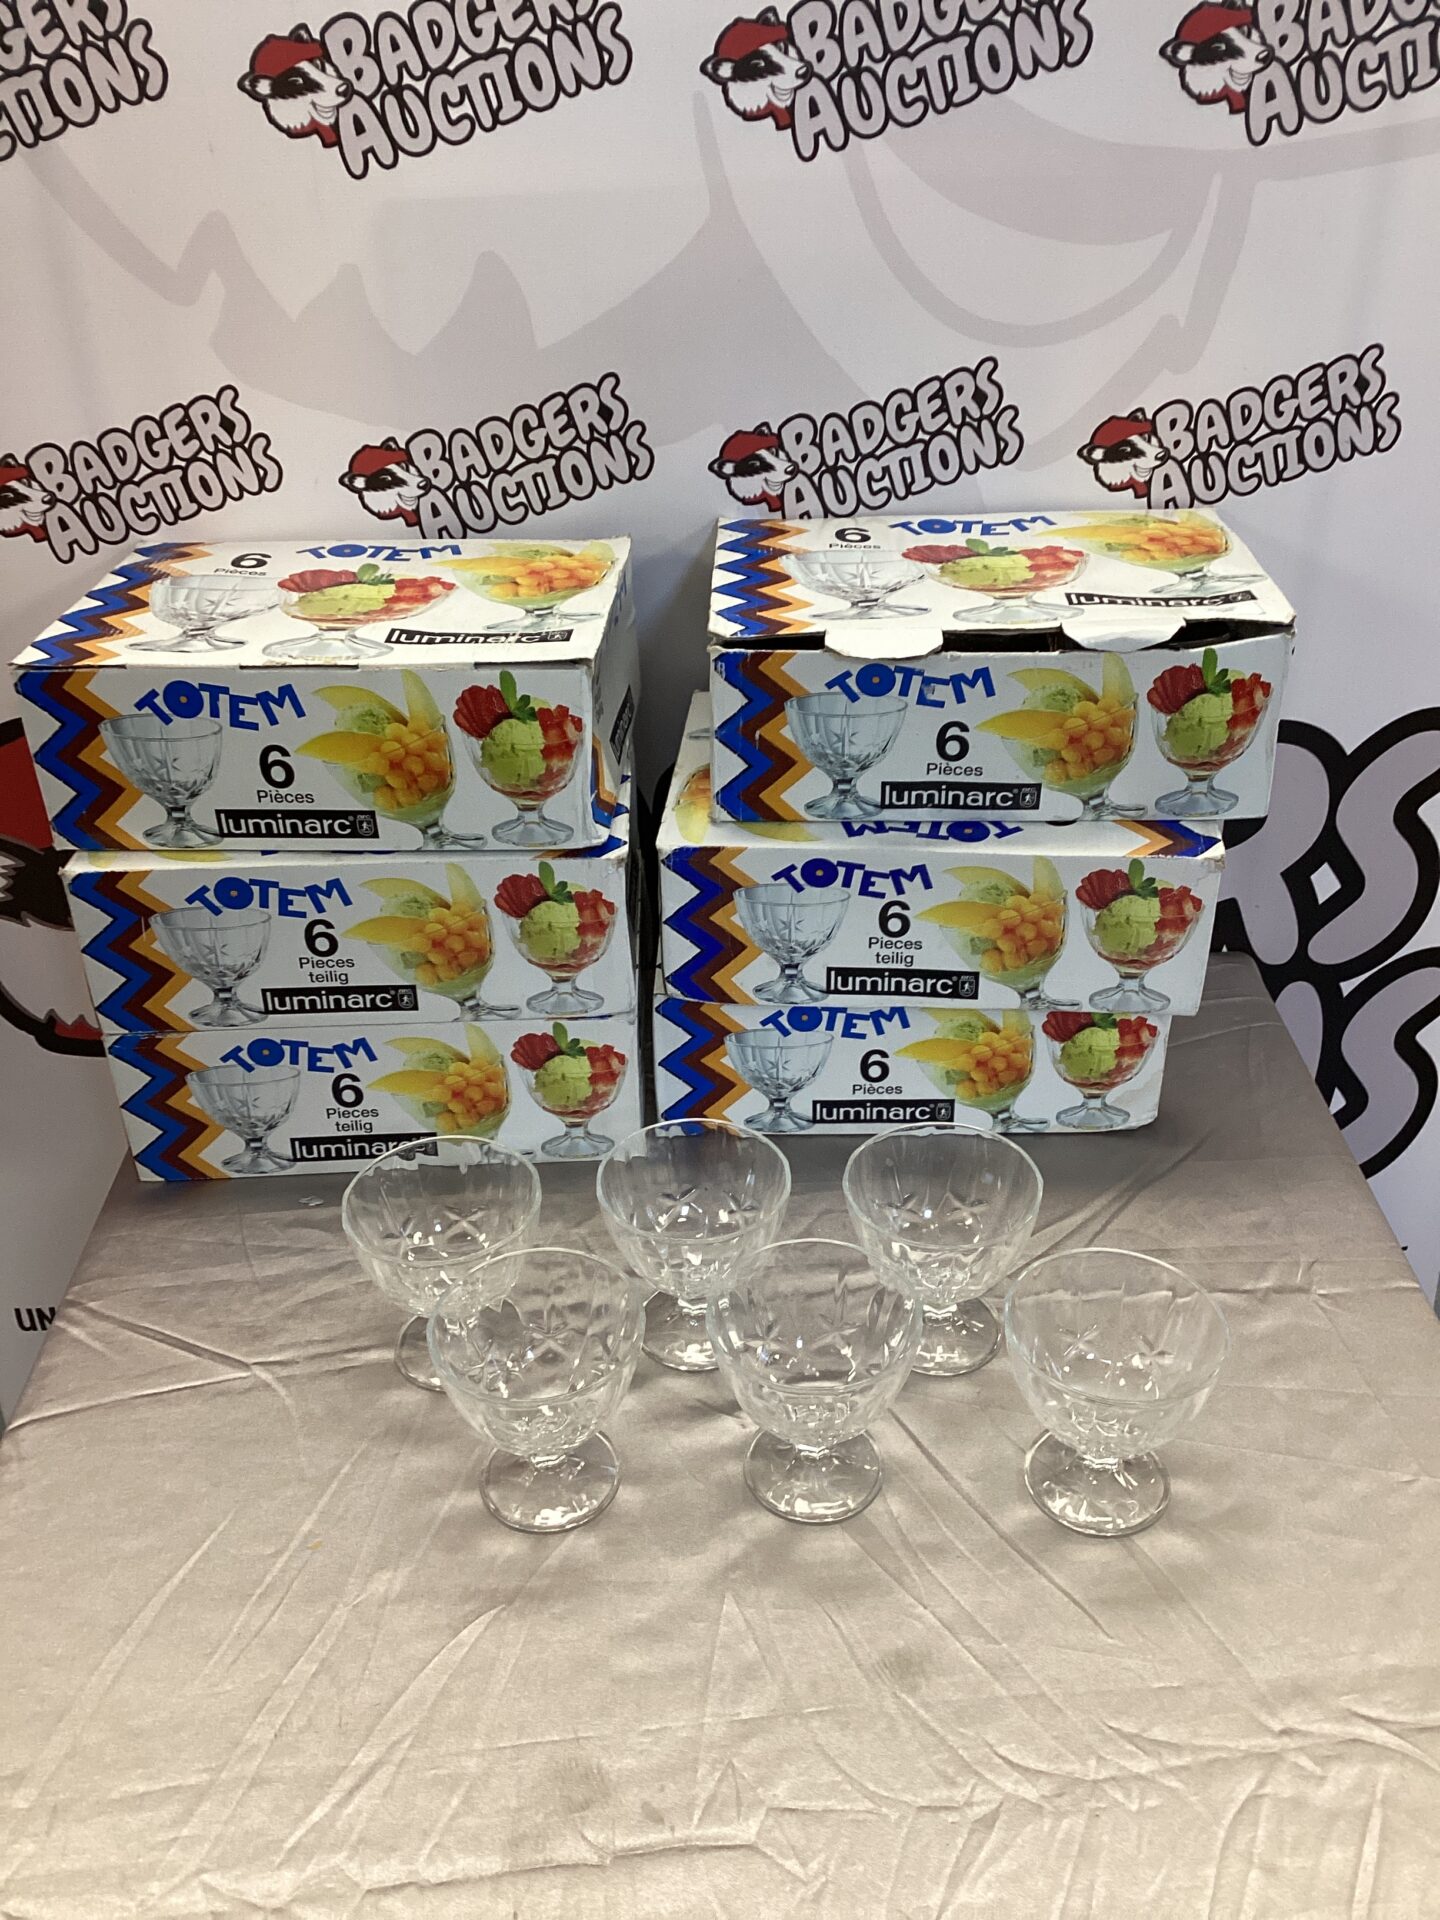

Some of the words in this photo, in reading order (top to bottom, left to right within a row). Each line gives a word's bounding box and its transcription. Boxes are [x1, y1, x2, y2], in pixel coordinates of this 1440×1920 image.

[318, 0, 598, 100] BADGE
[336, 2, 633, 180] AUCTIONS
[791, 0, 1094, 162] AUCTIONS
[776, 356, 1004, 472] BADGERS
[1150, 343, 1388, 461] BADGERS
[25, 385, 252, 503] BADGERS
[405, 372, 630, 490] BADGERS
[781, 403, 1024, 519] AUCTIONS
[1145, 391, 1402, 510] AUCTIONS
[44, 432, 283, 564] AUCTIONS
[415, 420, 655, 540] AUCTIONS
[835, 527, 872, 543] 6
[889, 515, 1057, 536] TOTEM
[230, 552, 272, 569] 6
[296, 544, 462, 562] TOTEM
[390, 630, 541, 644] luminarc
[824, 663, 996, 709] TOTEM
[134, 680, 306, 731] TOTEM
[935, 720, 970, 763] 6
[258, 744, 296, 788] 6
[926, 762, 984, 777] Pièces
[256, 788, 315, 804] Pièces
[884, 784, 1014, 807] luminarc
[220, 812, 352, 835] luminarc
[771, 857, 934, 899] TOTEM
[185, 876, 354, 919] TOTEM
[877, 899, 911, 938] 6
[303, 918, 340, 958] 6
[867, 937, 923, 951] Pieces
[298, 956, 356, 970] Pieces
[874, 951, 915, 967] teilig
[307, 969, 350, 986] teilig
[829, 972, 957, 996] luminarc
[266, 990, 393, 1012] luminarc
[759, 1006, 911, 1040] TOTEM
[220, 1037, 378, 1073] TOTEM
[859, 1048, 891, 1084] 6
[331, 1072, 364, 1108] 6
[851, 1083, 904, 1096] Pièces
[325, 1107, 380, 1121] Pieces
[334, 1119, 374, 1134] teilig
[814, 1104, 931, 1123] luminarc
